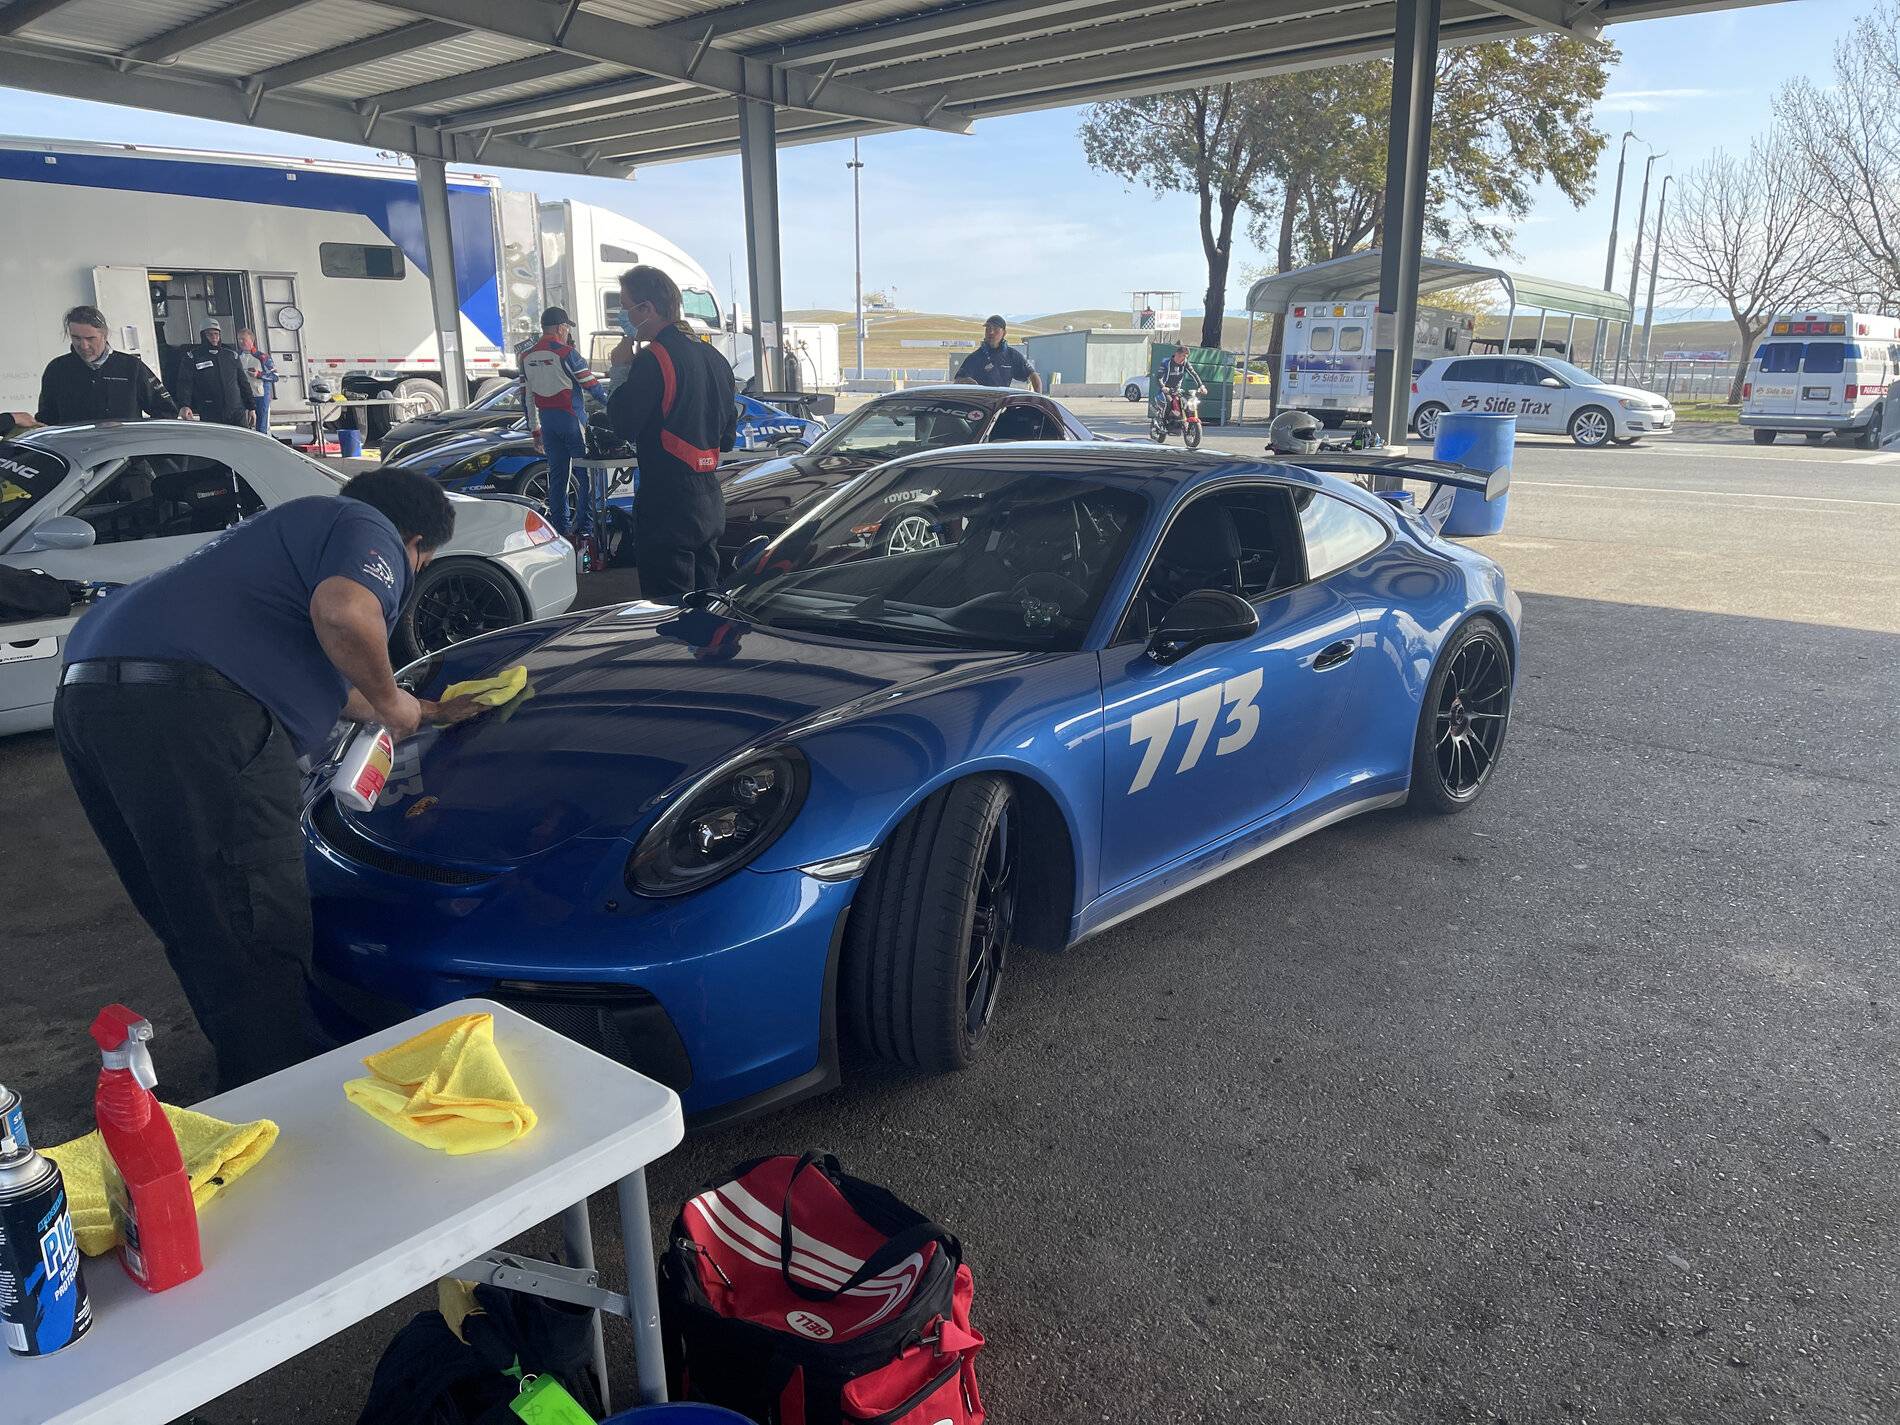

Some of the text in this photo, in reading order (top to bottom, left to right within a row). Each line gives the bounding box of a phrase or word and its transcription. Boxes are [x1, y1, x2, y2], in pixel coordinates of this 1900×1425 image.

[1321, 373, 1354, 383] Side Trax
[1484, 397, 1552, 415] Side Trax
[1127, 666, 1264, 796] 773
[795, 1314, 830, 1336] BELL
